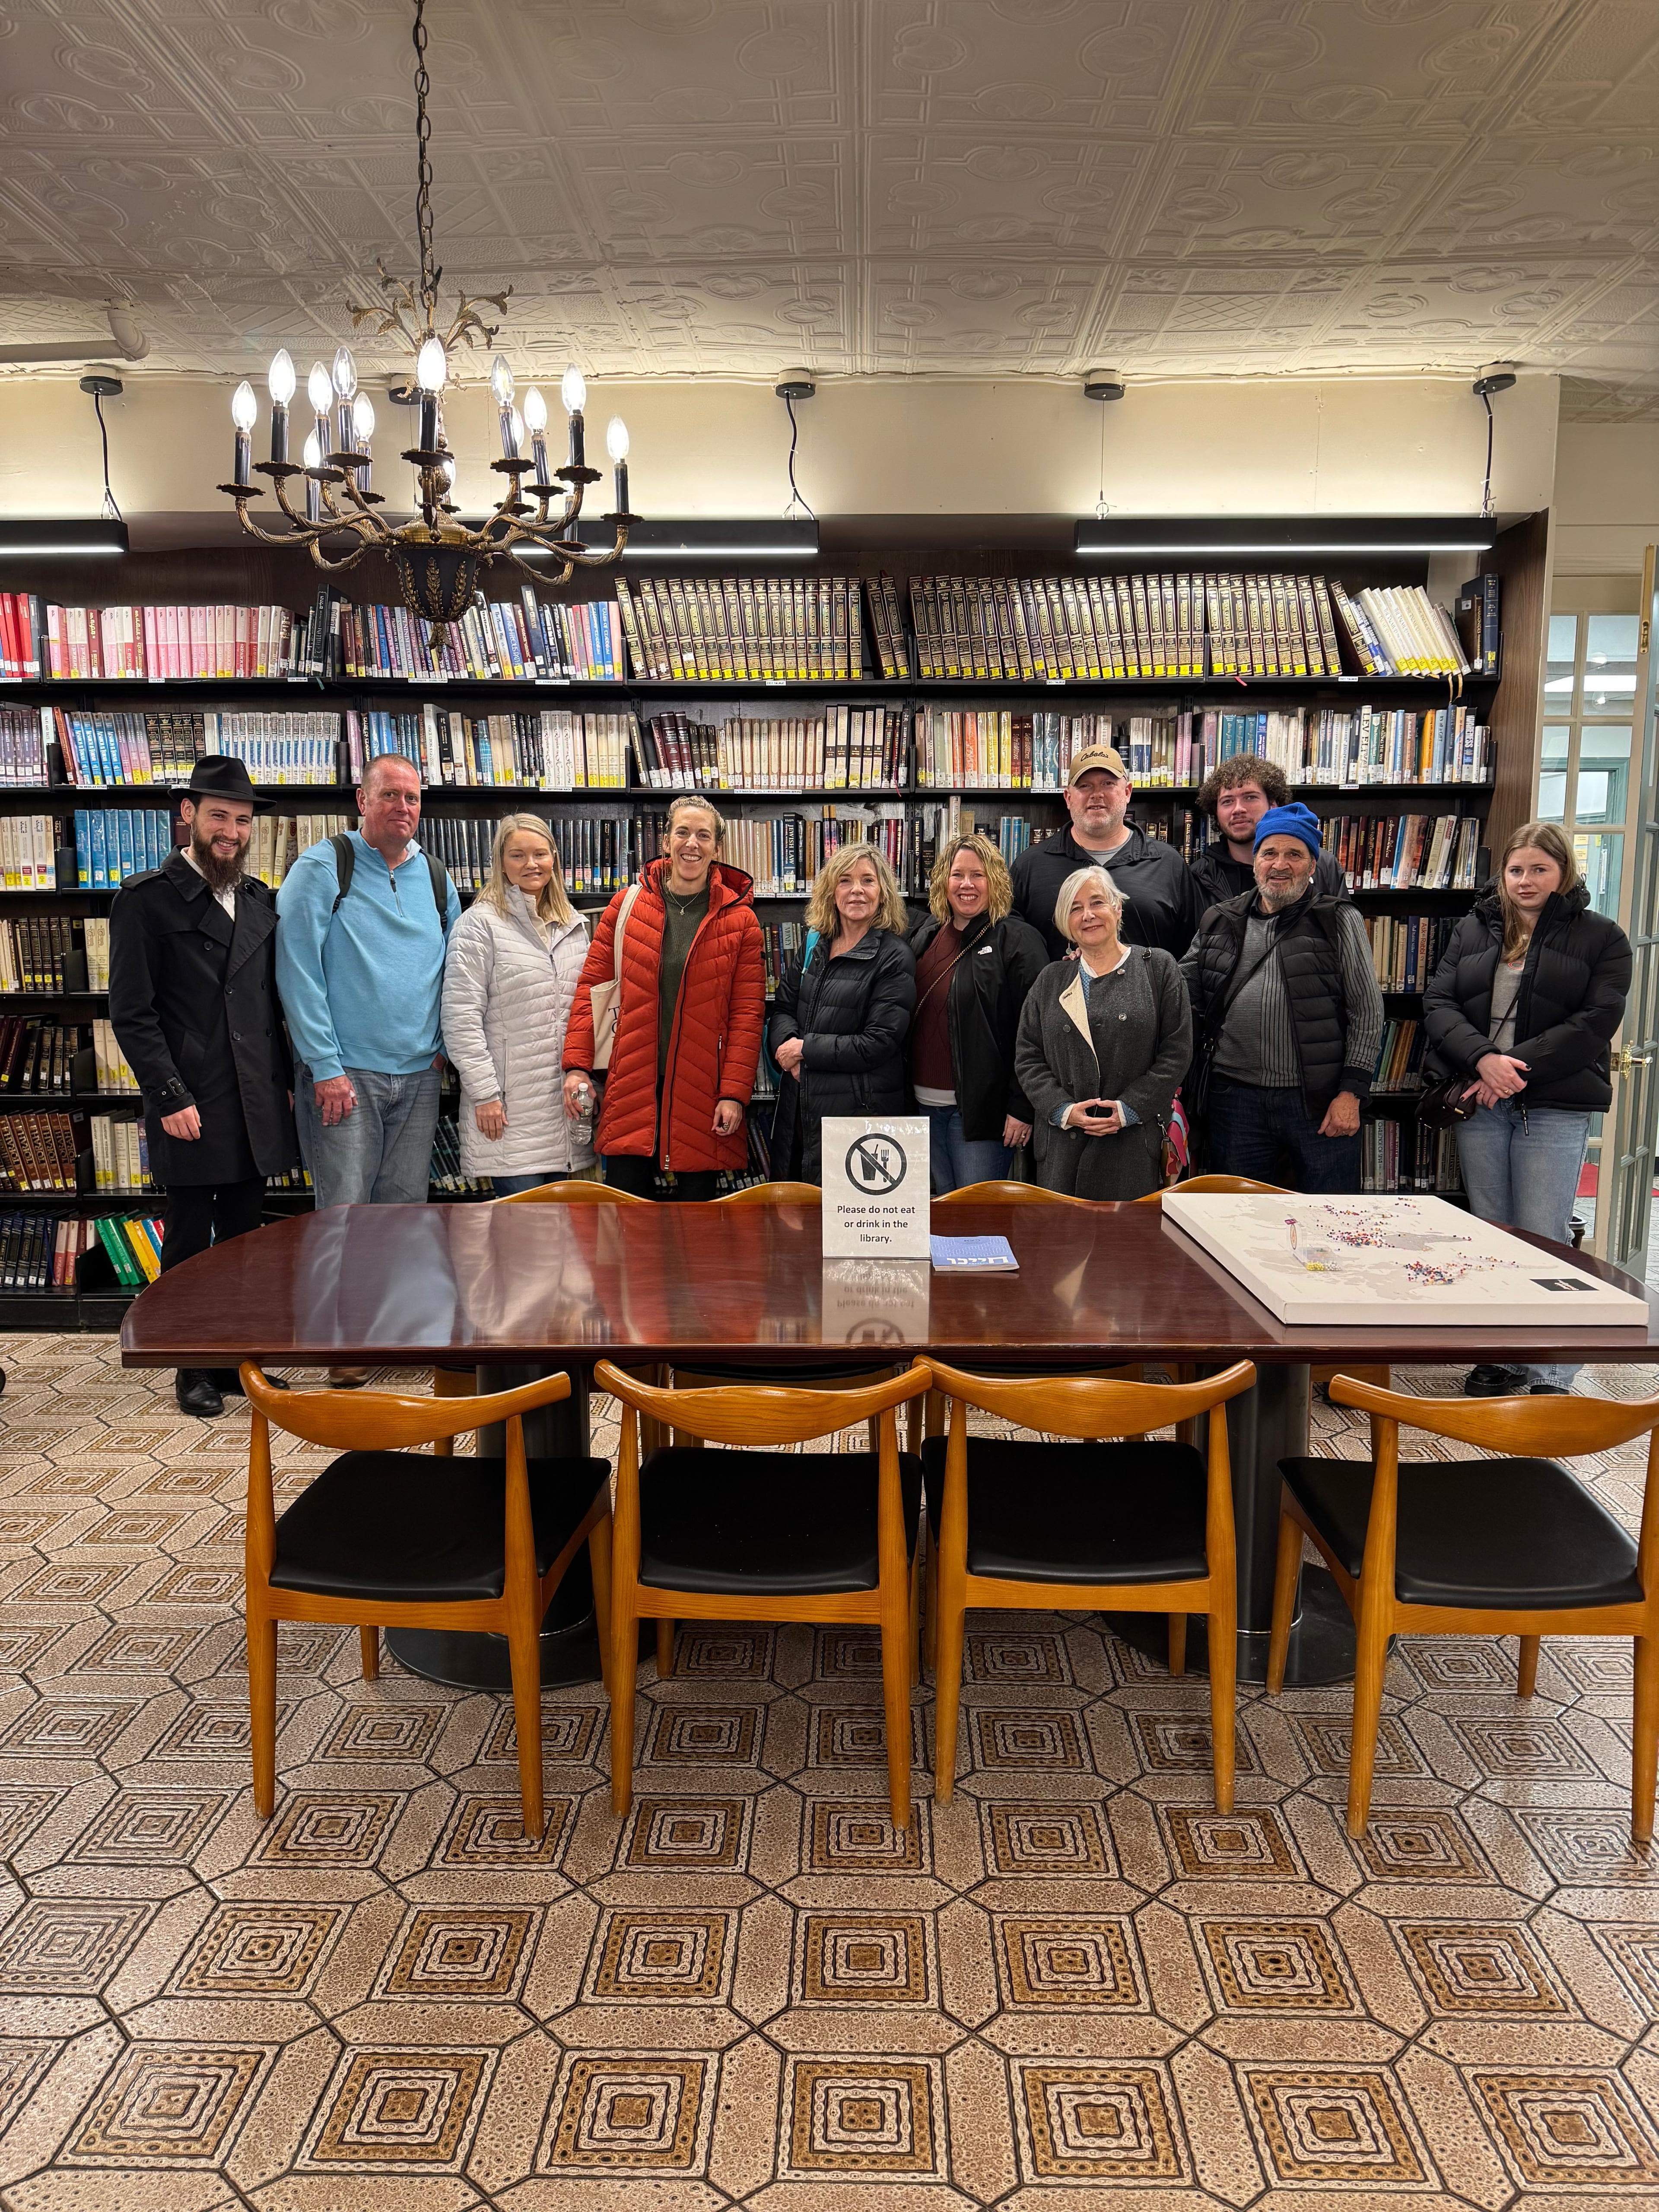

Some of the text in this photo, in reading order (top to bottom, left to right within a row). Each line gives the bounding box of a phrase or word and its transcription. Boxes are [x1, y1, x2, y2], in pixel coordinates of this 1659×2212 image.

[1081, 751, 1109, 762] Cabela's
[17, 1131, 34, 1163] TORAH
[31, 1130, 46, 1163] TORAH
[43, 1131, 57, 1164] TORAH
[837, 1206, 866, 1214] Please
[860, 1234, 892, 1243] library.
